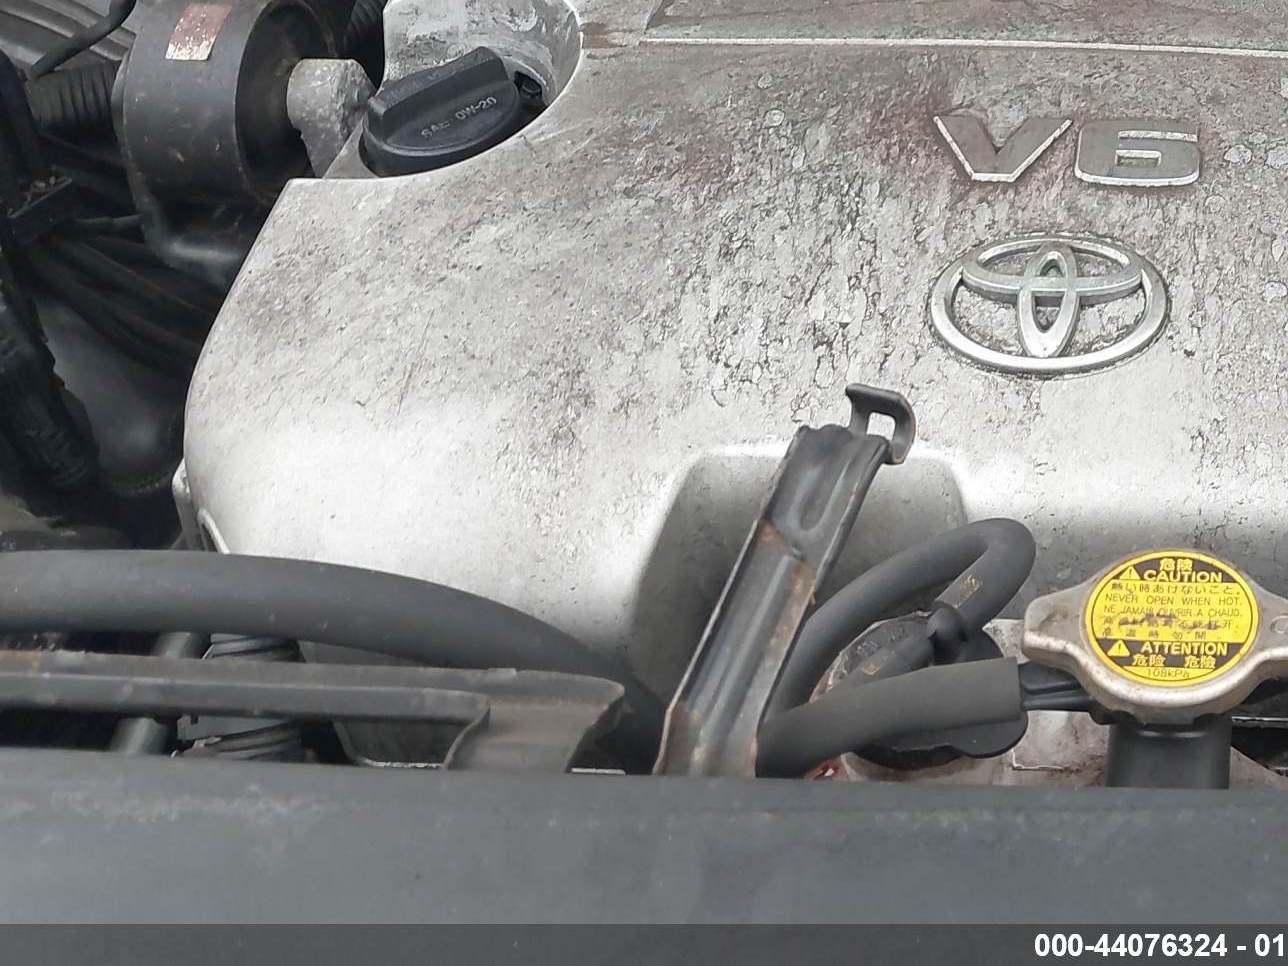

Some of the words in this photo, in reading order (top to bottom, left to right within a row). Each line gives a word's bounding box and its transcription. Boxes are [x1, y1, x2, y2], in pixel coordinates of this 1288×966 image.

[454, 96, 498, 121] 0W-20
[933, 115, 1203, 187] V6
[1143, 569, 1223, 583] CAUTION
[1105, 593, 1138, 604] NEVER
[1146, 595, 1175, 605] OPEN
[1182, 596, 1211, 606] WHEN
[1104, 604, 1117, 614] NE
[1197, 608, 1204, 617] A
[1140, 641, 1228, 656] ATTENTION
[1147, 668, 1190, 679] 108kPa
